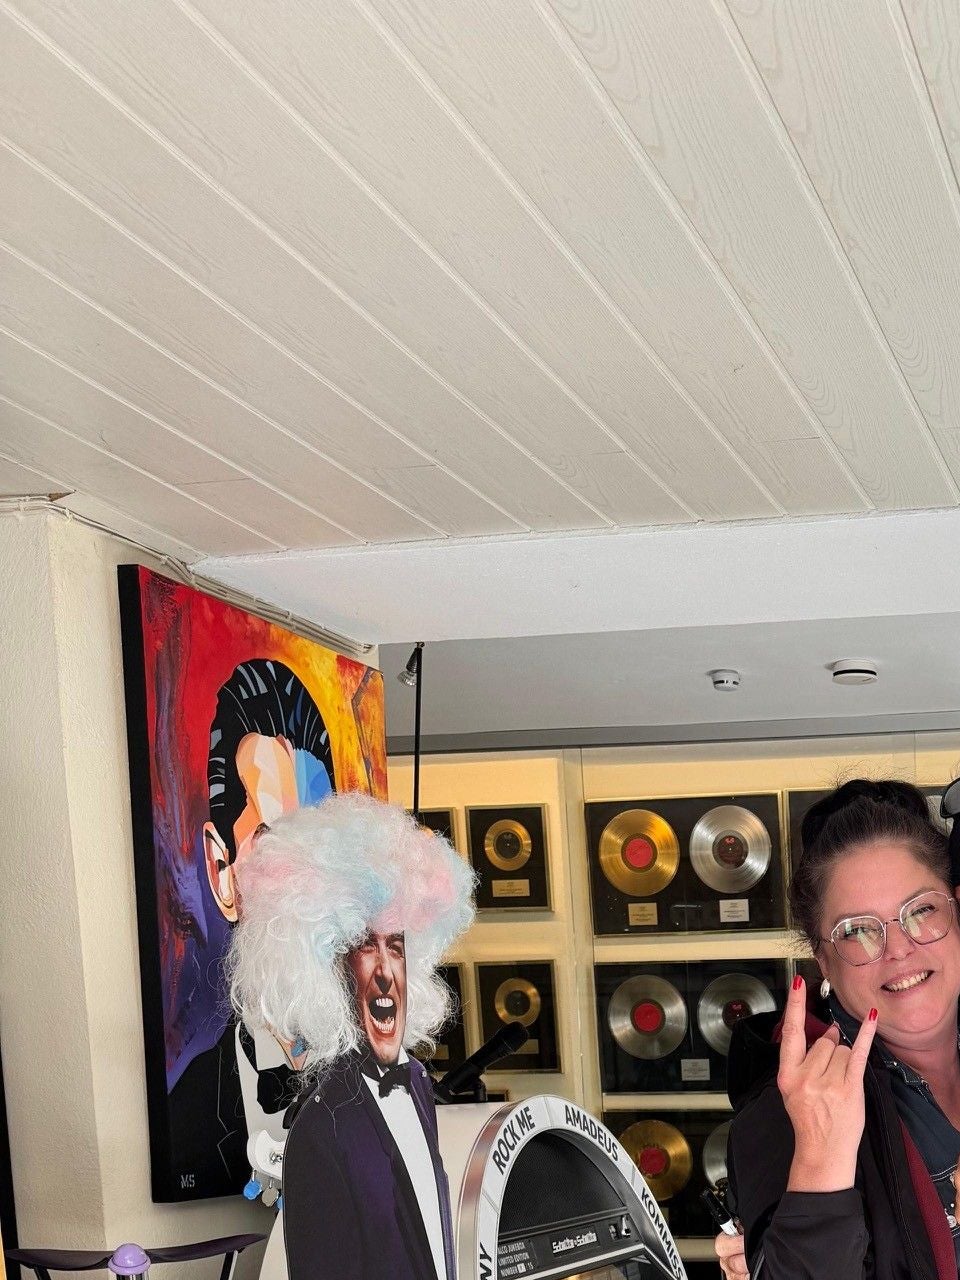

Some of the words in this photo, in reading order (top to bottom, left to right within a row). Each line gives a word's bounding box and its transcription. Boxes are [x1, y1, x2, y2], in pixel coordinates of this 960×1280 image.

[492, 1120, 522, 1175] ROCK
[517, 1106, 536, 1136] ME
[565, 1104, 619, 1162] AMADEUS
